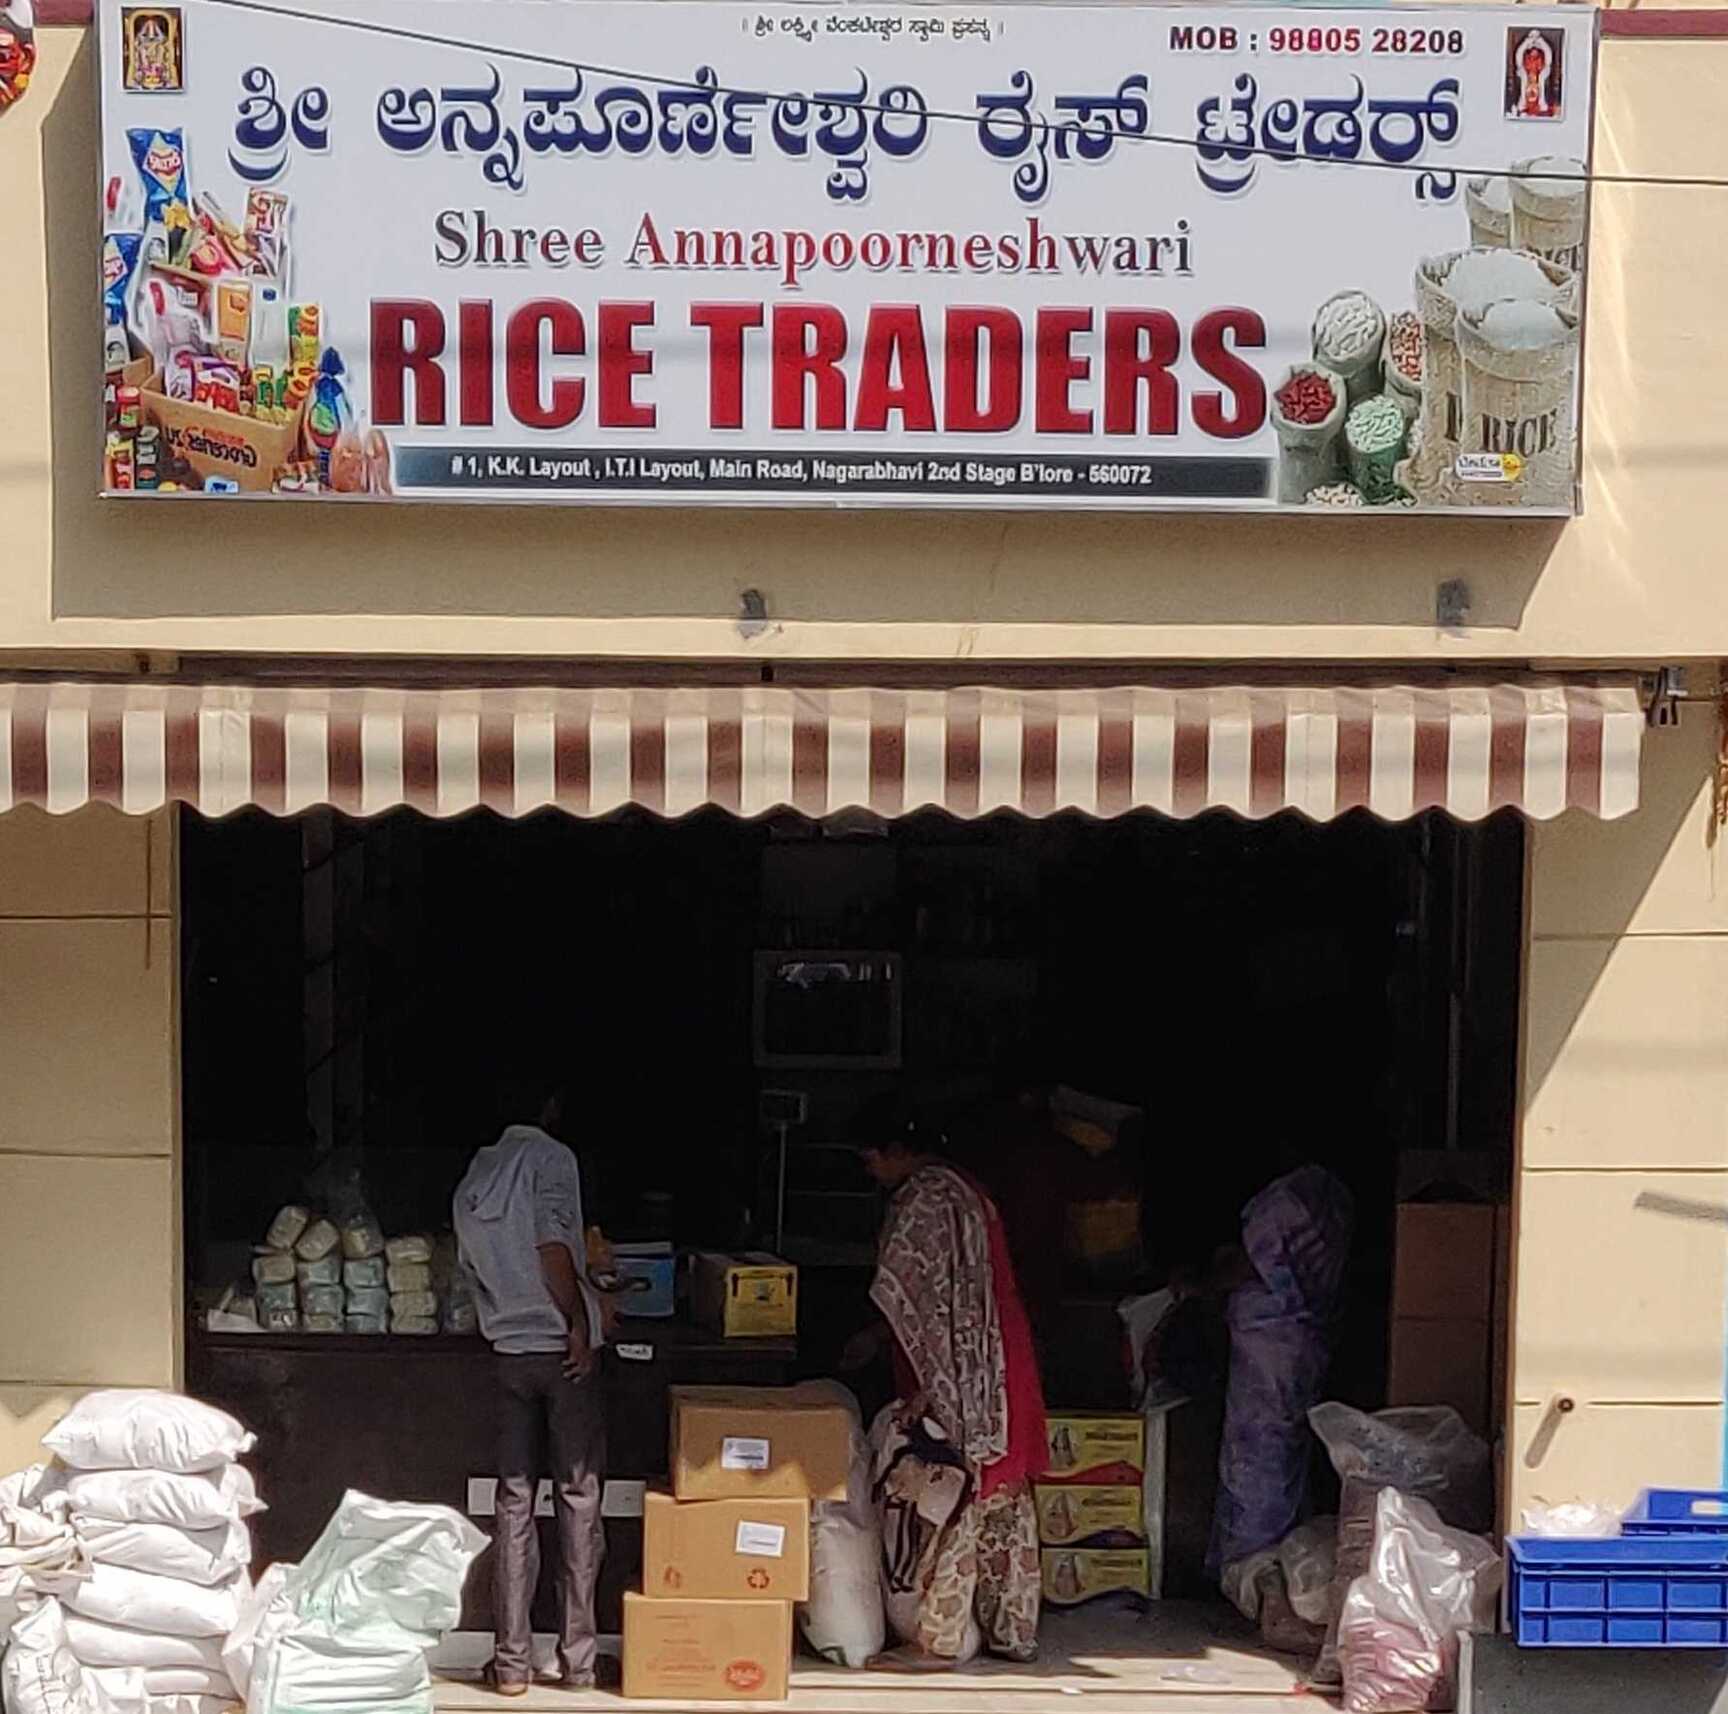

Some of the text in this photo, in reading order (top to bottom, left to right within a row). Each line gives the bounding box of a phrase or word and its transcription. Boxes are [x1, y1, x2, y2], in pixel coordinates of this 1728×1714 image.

[1170, 26, 1238, 50] MOB
[1269, 28, 1361, 52] 98805
[1371, 28, 1463, 53] 28208
[229, 66, 328, 180] ಶ್ರೀ
[377, 62, 928, 200] ಅನ್ನಪೂರ್ಣೇಶ್ವರಿ
[976, 70, 1148, 202] ರೈಸ್
[434, 211, 1194, 288] Shree Annapoorneshwari
[371, 299, 1267, 438] RICE TRADERS
[487, 456, 525, 476] K.K.
[640, 458, 705, 482] Layout,
[709, 459, 751, 478] Main
[756, 459, 808, 482] Road,
[812, 460, 923, 484] Nagarabhavi
[927, 461, 961, 481] 2nd
[965, 462, 1016, 485] Stage
[1089, 463, 1153, 484] 560072
